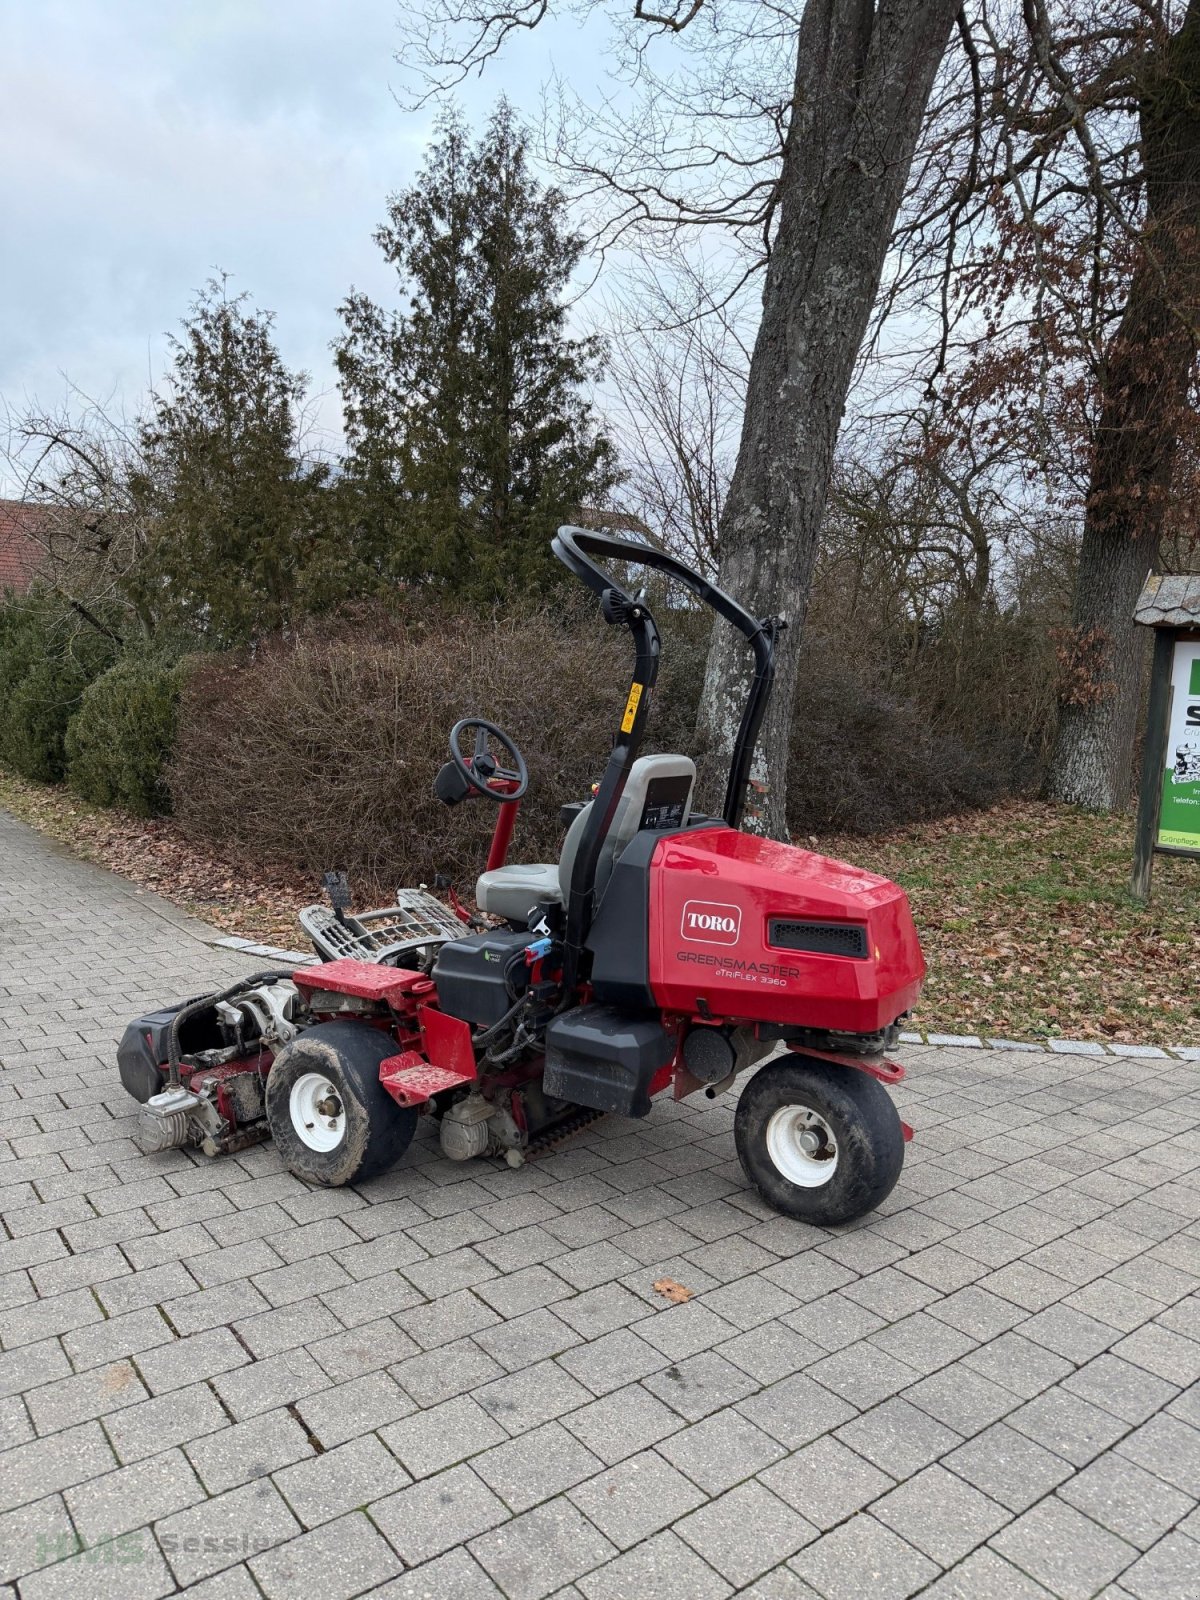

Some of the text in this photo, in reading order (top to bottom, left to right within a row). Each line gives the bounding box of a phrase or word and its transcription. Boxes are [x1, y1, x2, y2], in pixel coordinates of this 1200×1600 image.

[687, 912, 735, 933] TORO
[676, 951, 800, 979] GREENSMASTER
[760, 976, 787, 987] 3360
